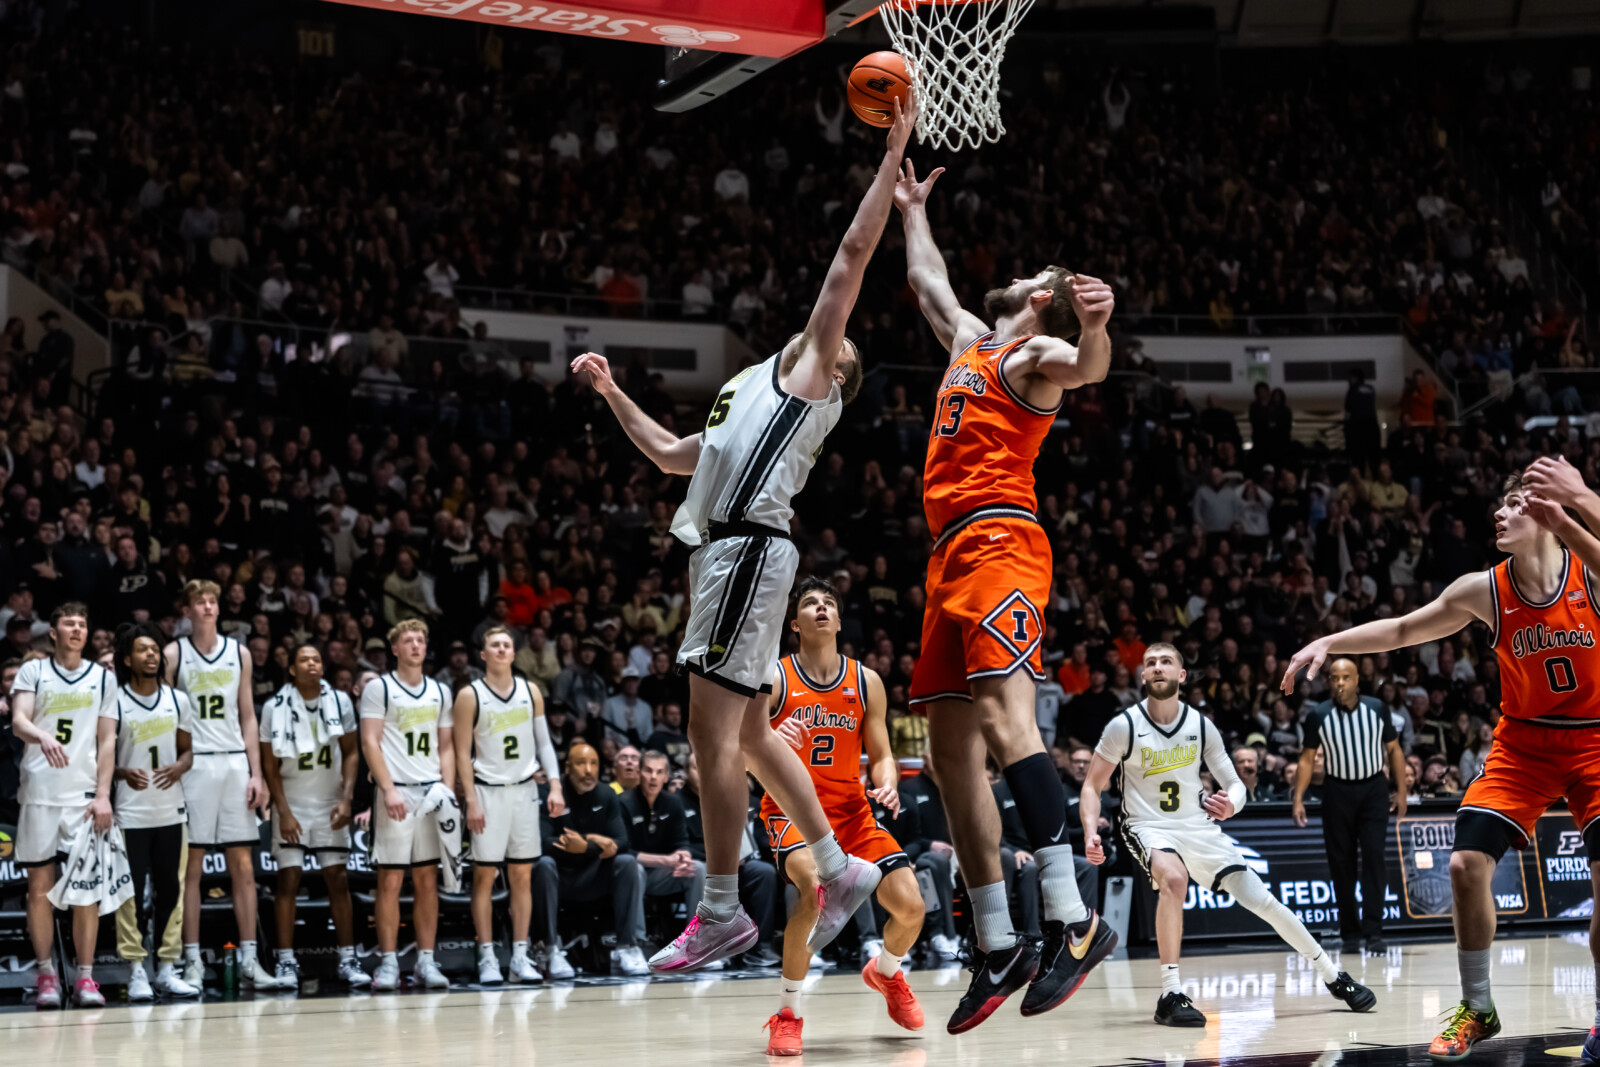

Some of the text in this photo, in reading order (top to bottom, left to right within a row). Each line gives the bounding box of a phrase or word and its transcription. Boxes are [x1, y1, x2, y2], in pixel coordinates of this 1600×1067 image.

[934, 394, 967, 438] 13
[1011, 609, 1028, 642] I
[1512, 623, 1595, 659] Illinois
[1543, 656, 1578, 694] 0
[197, 694, 225, 719] 12
[55, 719, 73, 745] 5
[405, 731, 430, 757] 14
[148, 745, 159, 769] 1
[298, 745, 333, 771] 24
[503, 735, 519, 760] 2
[810, 734, 835, 766] 2
[1141, 744, 1197, 770] Purdue
[1159, 781, 1180, 813] 3
[1546, 857, 1590, 873] PURDU
[1548, 872, 1591, 881] UNIVERSI
[1280, 880, 1398, 905] FEDL
[1495, 894, 1523, 908] VISA
[1296, 908, 1338, 922] REDIT
